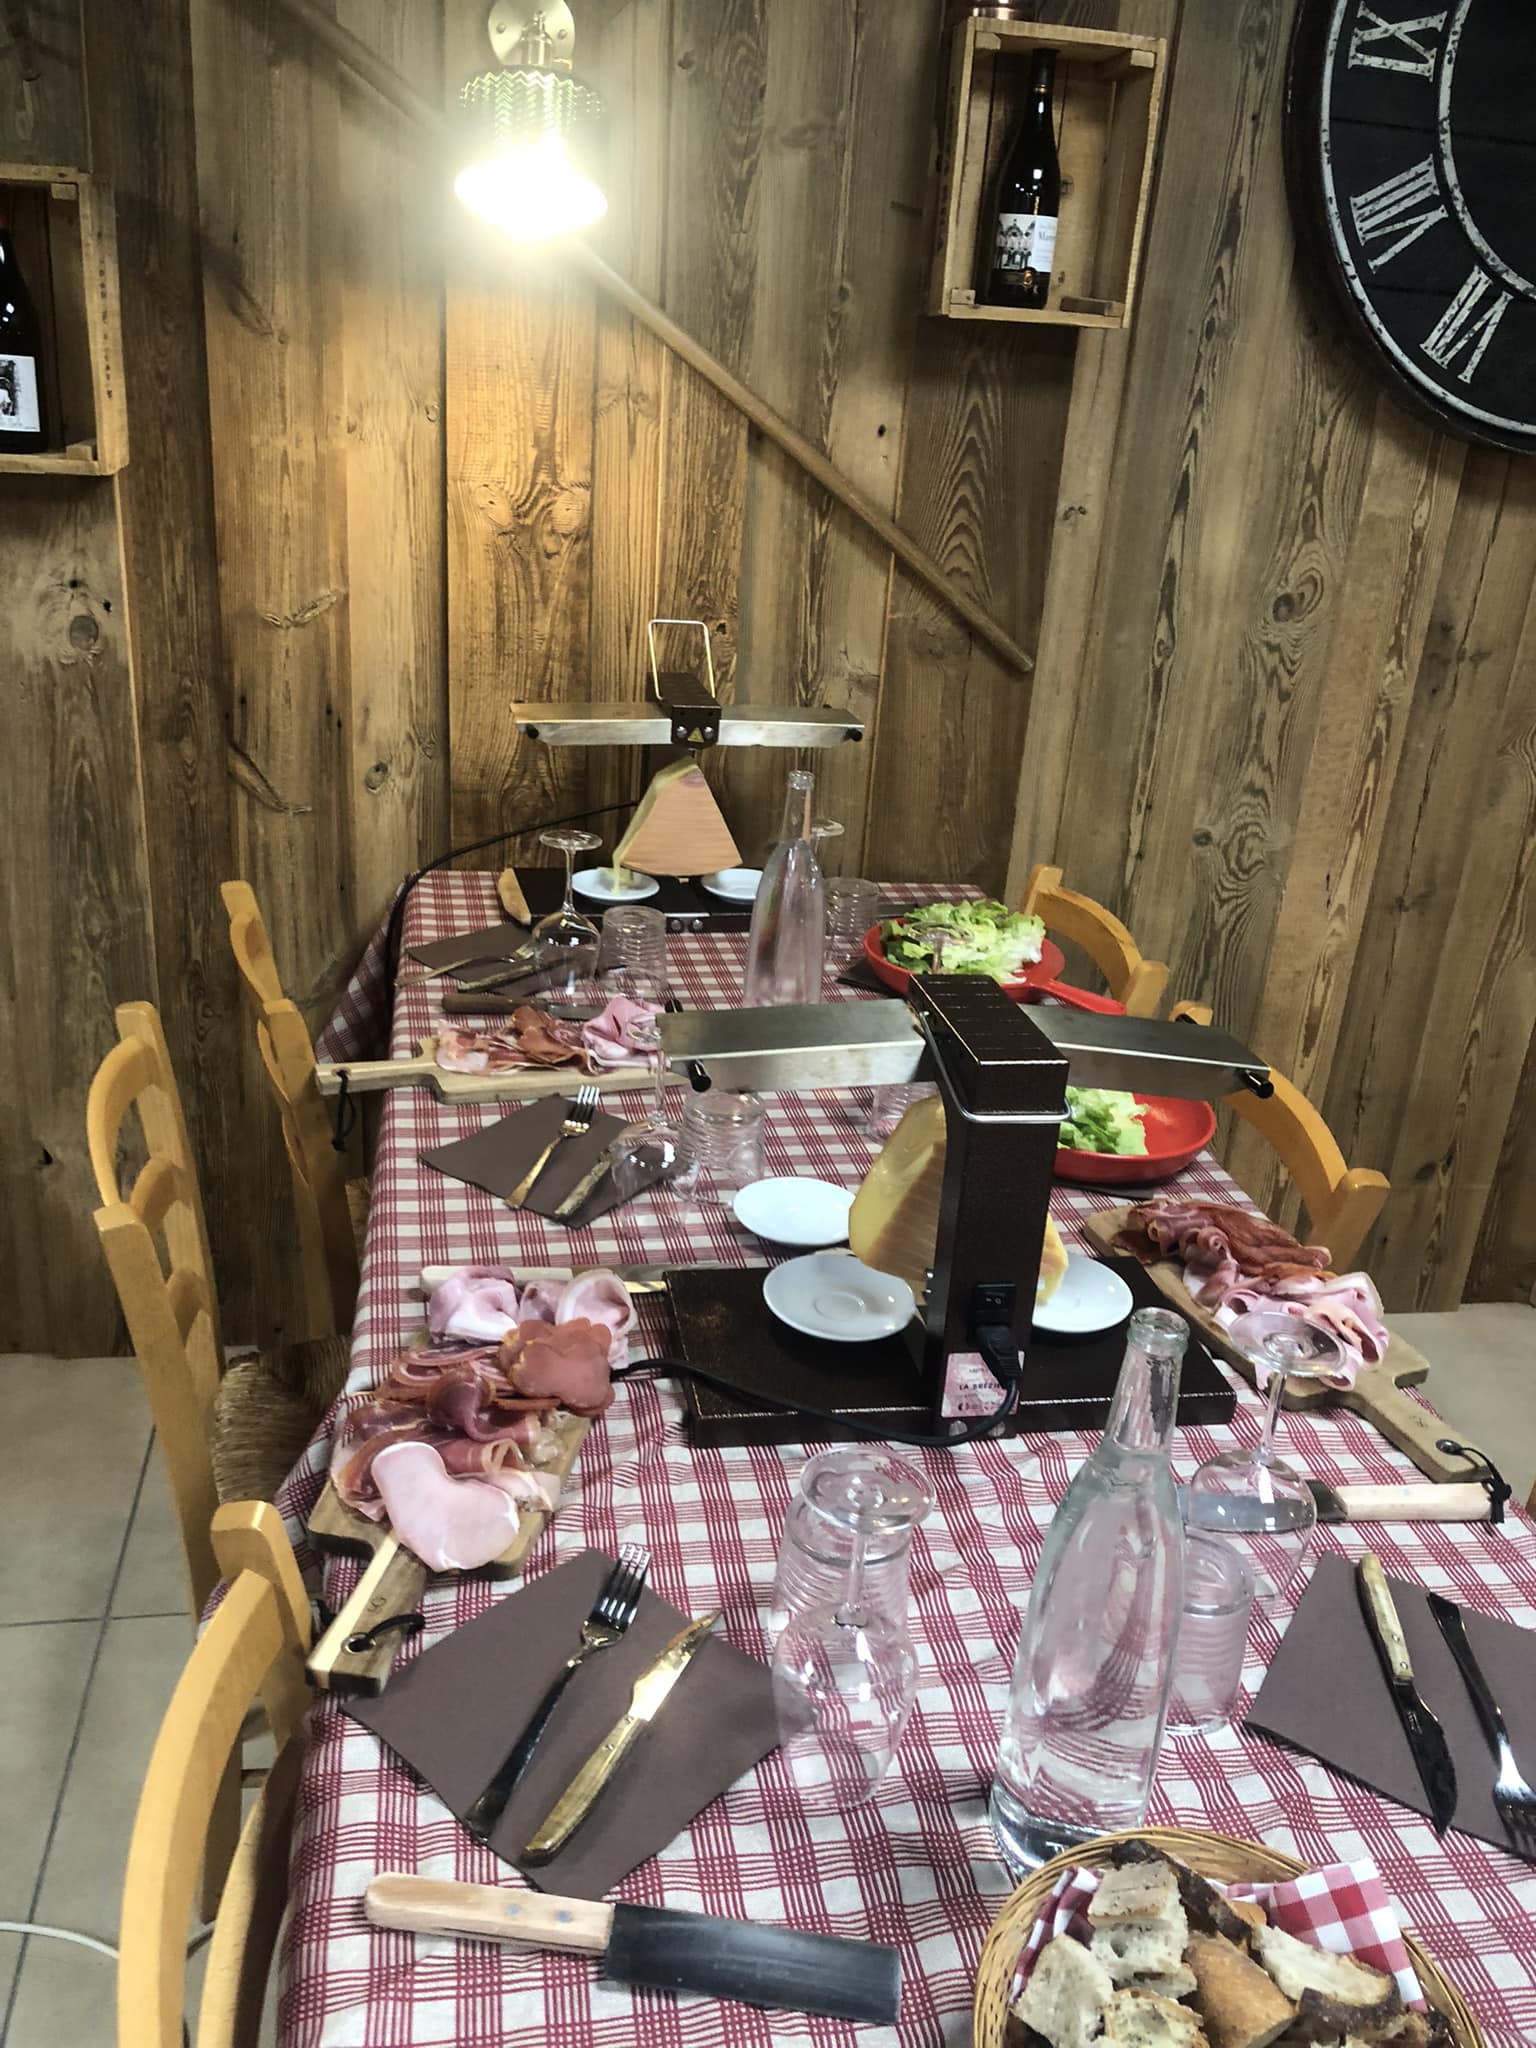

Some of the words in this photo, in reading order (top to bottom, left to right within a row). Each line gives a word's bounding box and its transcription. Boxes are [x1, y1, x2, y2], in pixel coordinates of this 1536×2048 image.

[1348, 1, 1448, 82] IX
[1350, 154, 1448, 274] VIII
[1419, 265, 1514, 384] VII
